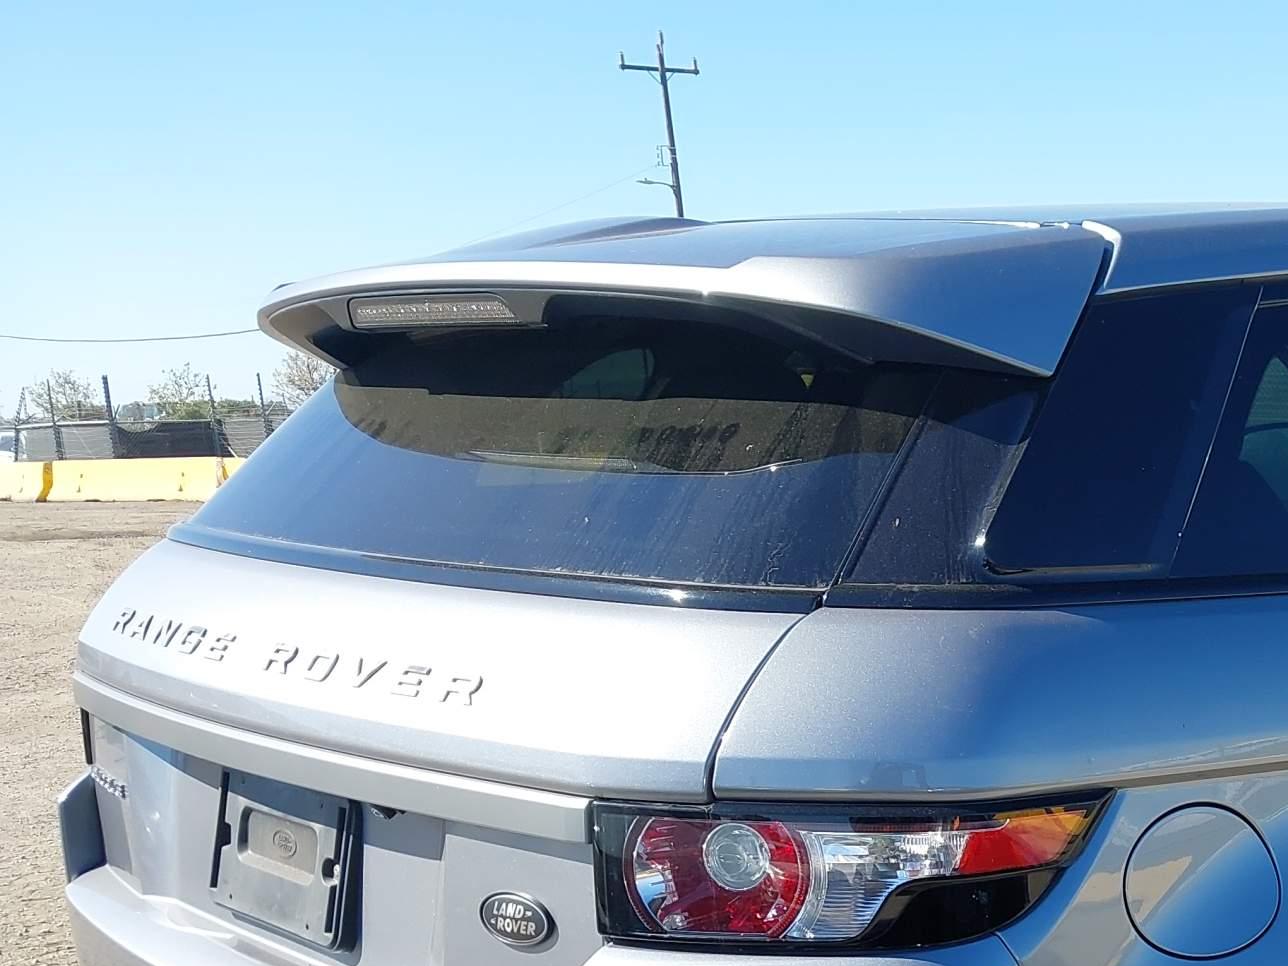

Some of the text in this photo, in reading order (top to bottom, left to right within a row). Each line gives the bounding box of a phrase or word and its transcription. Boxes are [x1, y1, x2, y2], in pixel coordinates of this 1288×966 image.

[112, 607, 484, 706] RANGE ROVER
[492, 900, 525, 919] LAND
[496, 916, 536, 936] ROVER
